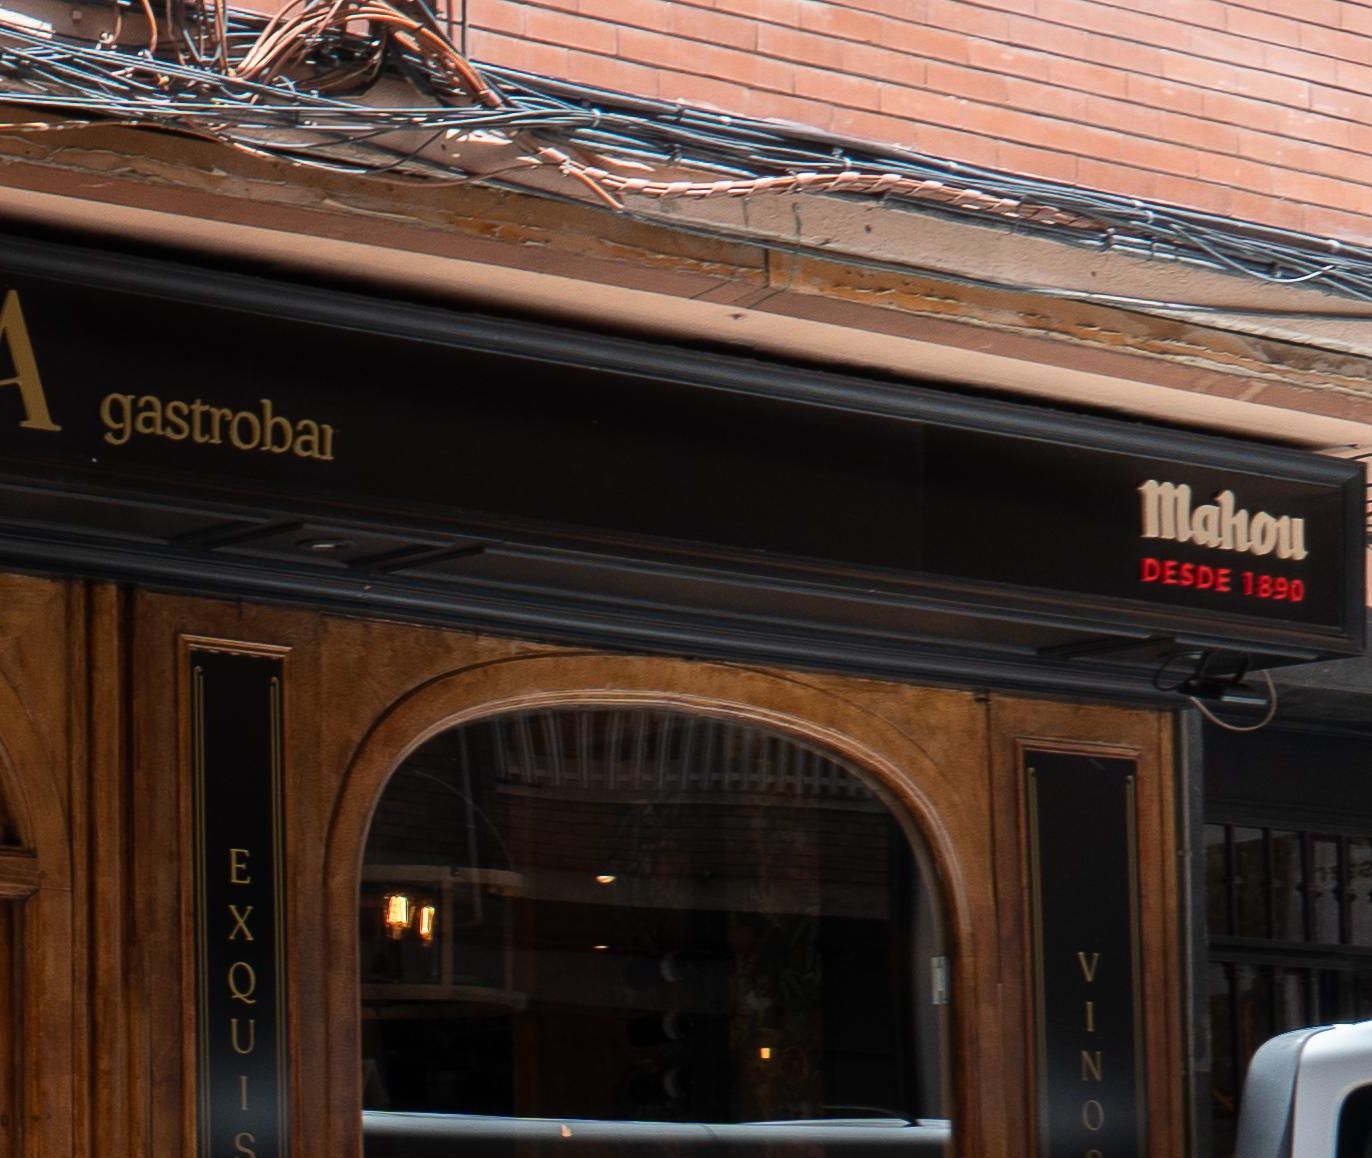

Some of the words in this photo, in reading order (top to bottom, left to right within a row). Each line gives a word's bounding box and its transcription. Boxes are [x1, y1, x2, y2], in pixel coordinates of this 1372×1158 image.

[100, 392, 335, 461] gastrobar
[1137, 479, 1309, 560] Mahou
[1140, 557, 1233, 592] DESDE
[1242, 571, 1304, 602] 1890
